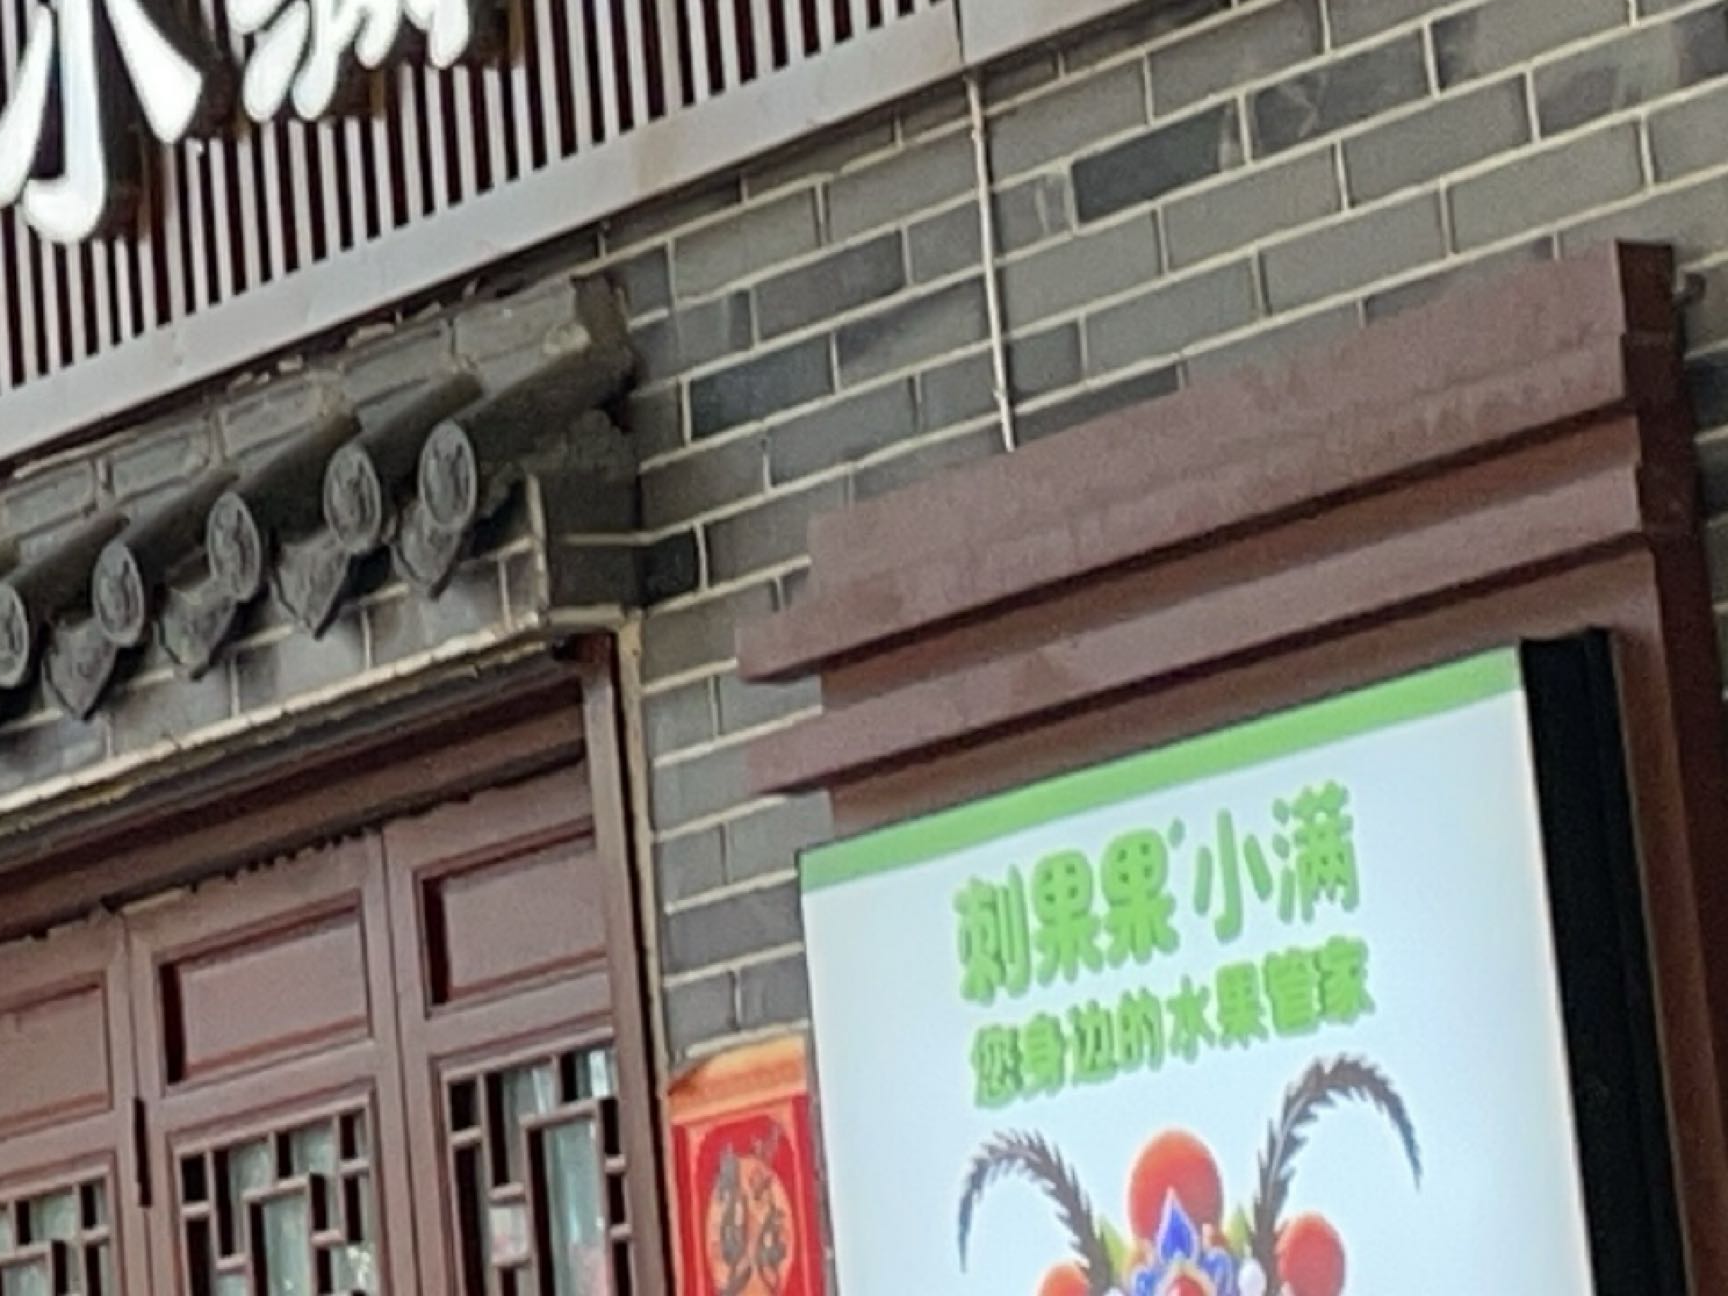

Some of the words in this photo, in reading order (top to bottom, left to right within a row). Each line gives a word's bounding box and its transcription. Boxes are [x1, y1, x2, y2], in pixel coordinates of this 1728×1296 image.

[971, 935, 1376, 1111] 您身边的水果管家
